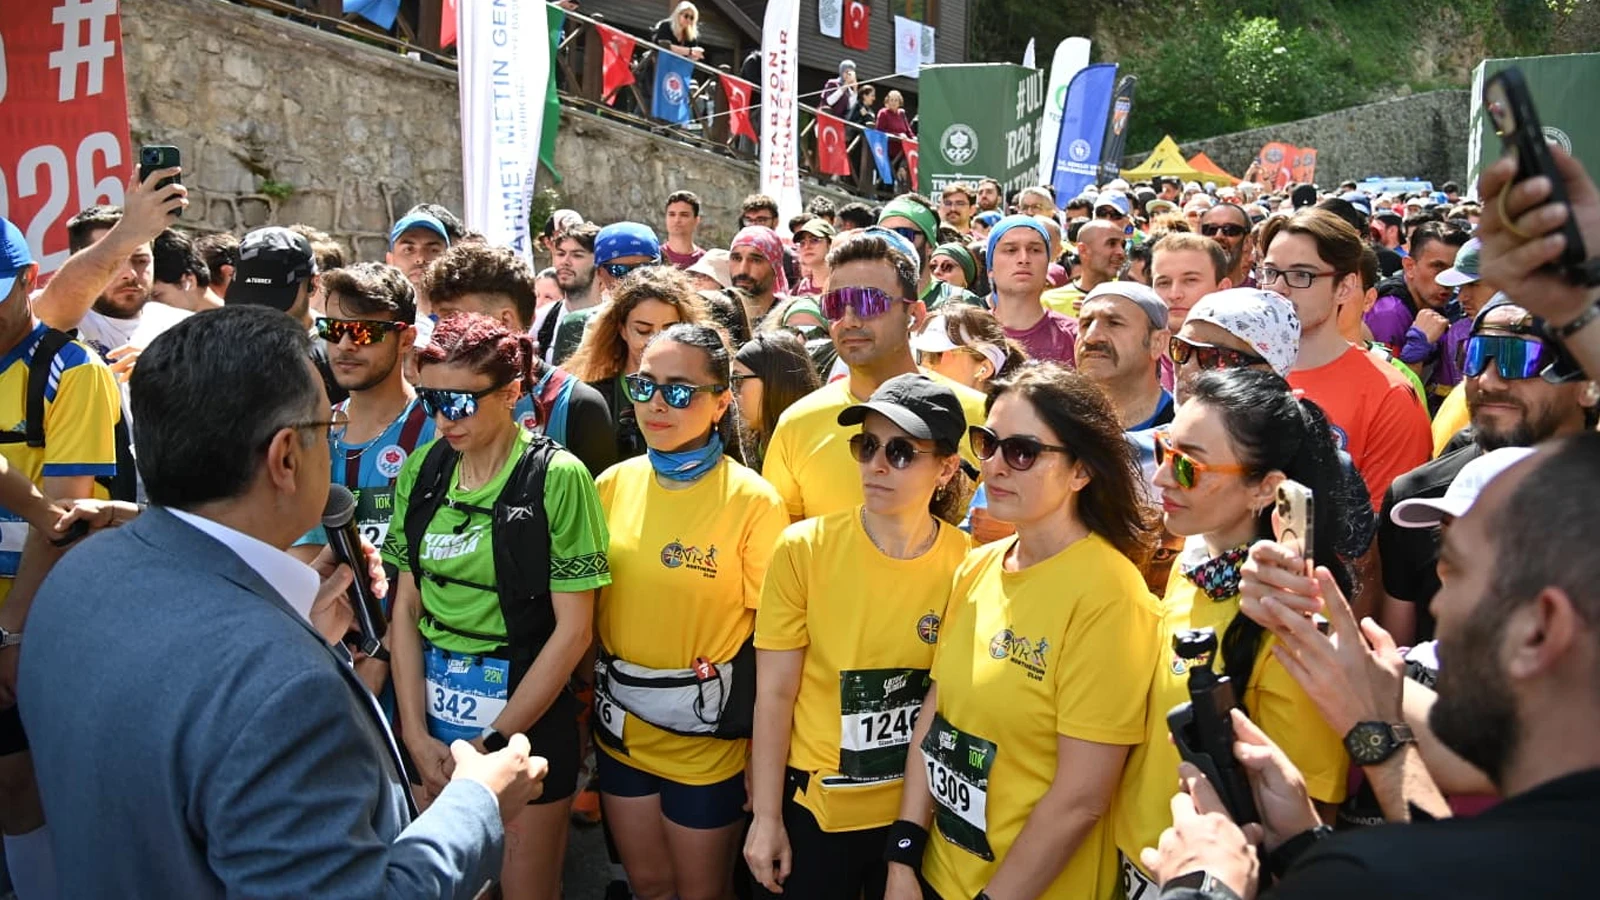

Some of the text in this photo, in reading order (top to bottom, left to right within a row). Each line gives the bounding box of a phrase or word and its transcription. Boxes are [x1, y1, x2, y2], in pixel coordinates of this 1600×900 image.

[767, 50, 780, 185] TRABZON
[498, 157, 525, 253] AHMET
[375, 497, 391, 509] 10K
[484, 669, 503, 684] 22K
[434, 687, 478, 721] 342
[968, 749, 986, 769] 10K
[927, 761, 971, 812] 1309
